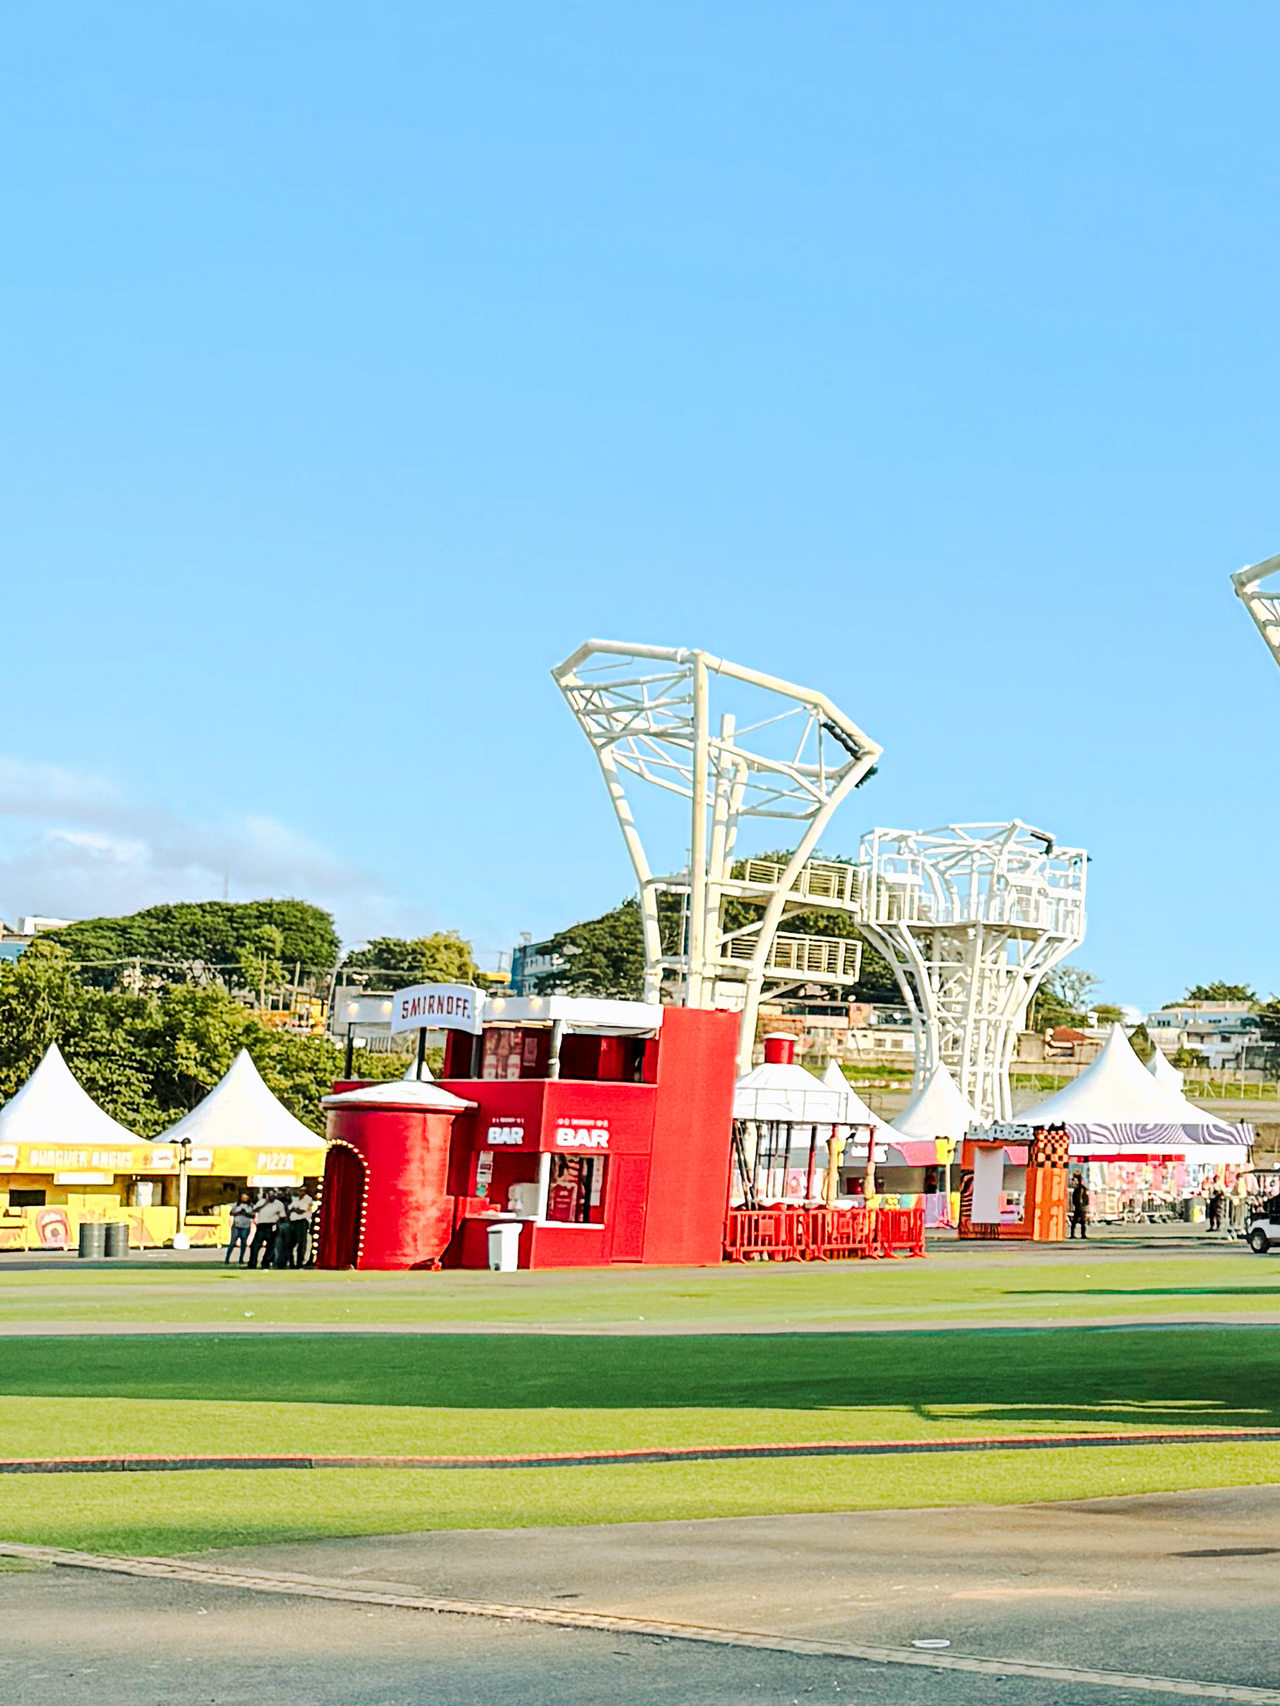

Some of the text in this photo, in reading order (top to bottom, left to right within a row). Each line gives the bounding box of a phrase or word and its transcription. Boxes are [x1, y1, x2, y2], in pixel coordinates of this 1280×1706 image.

[401, 995, 470, 1020] SMIRNOFF
[487, 1127, 525, 1145] BAR
[556, 1127, 610, 1148] BAR
[92, 1150, 133, 1168] ANGUS
[257, 1152, 295, 1170] PIZZA
